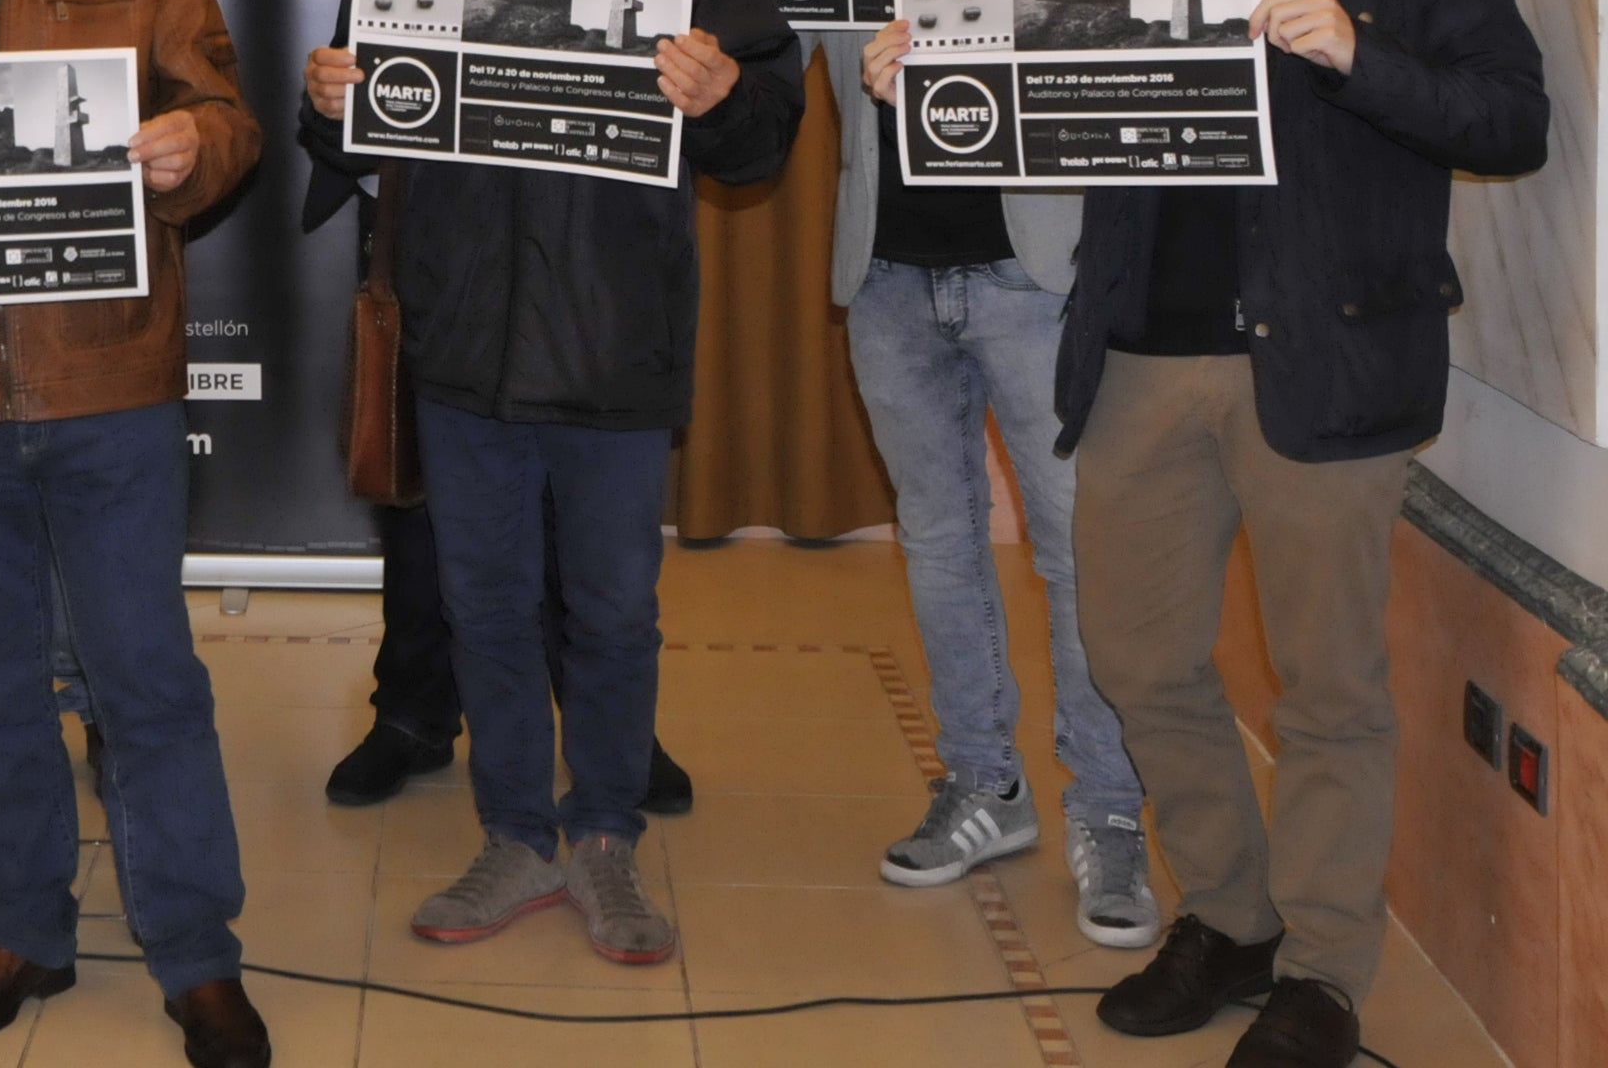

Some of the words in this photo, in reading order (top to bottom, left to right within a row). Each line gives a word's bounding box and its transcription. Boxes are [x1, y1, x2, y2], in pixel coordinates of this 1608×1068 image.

[469, 65, 485, 74] Del
[486, 66, 496, 75] 17
[505, 68, 518, 77] 20
[519, 69, 531, 78] de
[532, 70, 581, 82] noviembre
[1026, 75, 1043, 85] Del
[1044, 75, 1055, 84] 17
[1064, 75, 1078, 84] 20
[1079, 74, 1093, 84] de
[1094, 73, 1148, 84] noviembre
[376, 83, 433, 103] MARTE
[469, 77, 510, 89] Auditorio
[518, 82, 551, 92] Palacio
[552, 84, 564, 93] de
[565, 86, 612, 99] Congresos
[614, 90, 626, 99] de
[627, 91, 669, 102] Castellón
[1027, 89, 1071, 99] Auditorio
[1080, 89, 1116, 98] Palacio
[1117, 88, 1130, 98] de
[1131, 88, 1184, 99] Congresos
[1185, 87, 1199, 97] de
[1200, 87, 1247, 96] Castellón
[929, 106, 990, 123] MARTE
[3, 212, 16, 221] de
[68, 210, 81, 218] de
